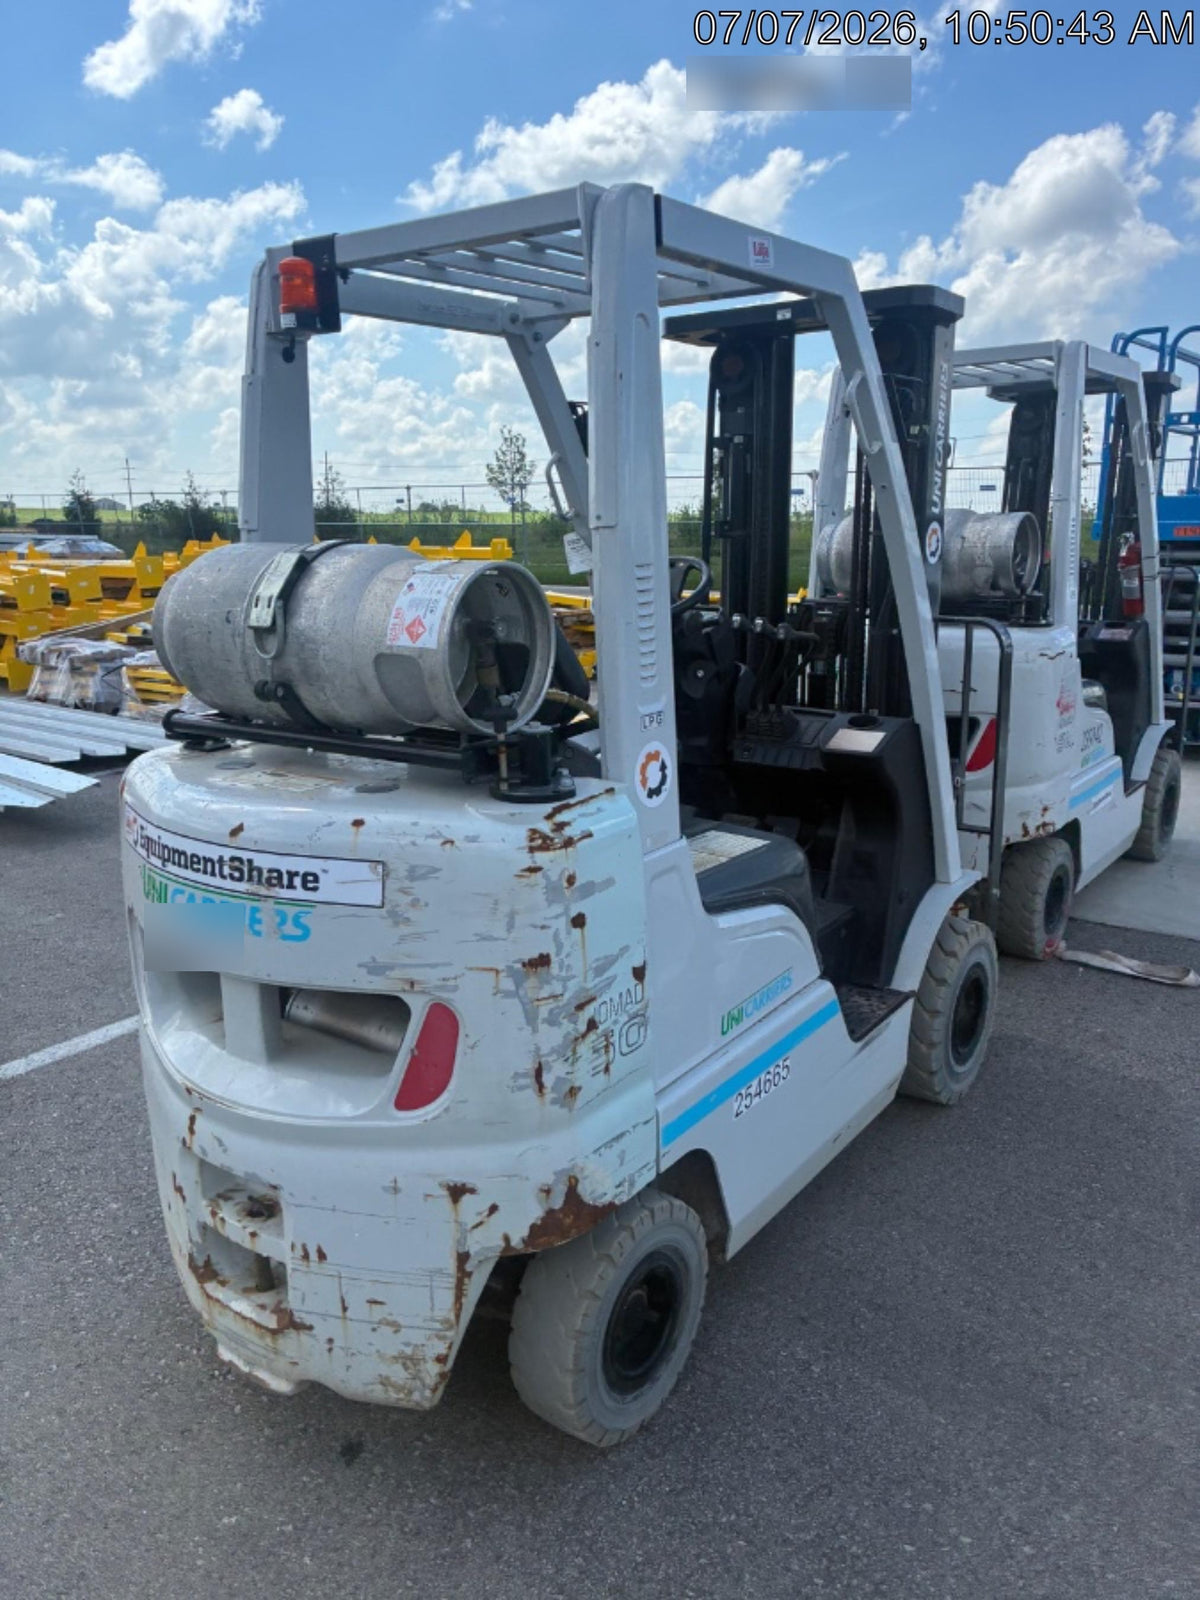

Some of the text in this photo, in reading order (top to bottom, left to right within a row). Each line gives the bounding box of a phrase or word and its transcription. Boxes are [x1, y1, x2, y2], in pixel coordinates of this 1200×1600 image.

[641, 711, 664, 731] LPG
[139, 824, 320, 893] EquipmentShare
[732, 1057, 791, 1119] 254665
